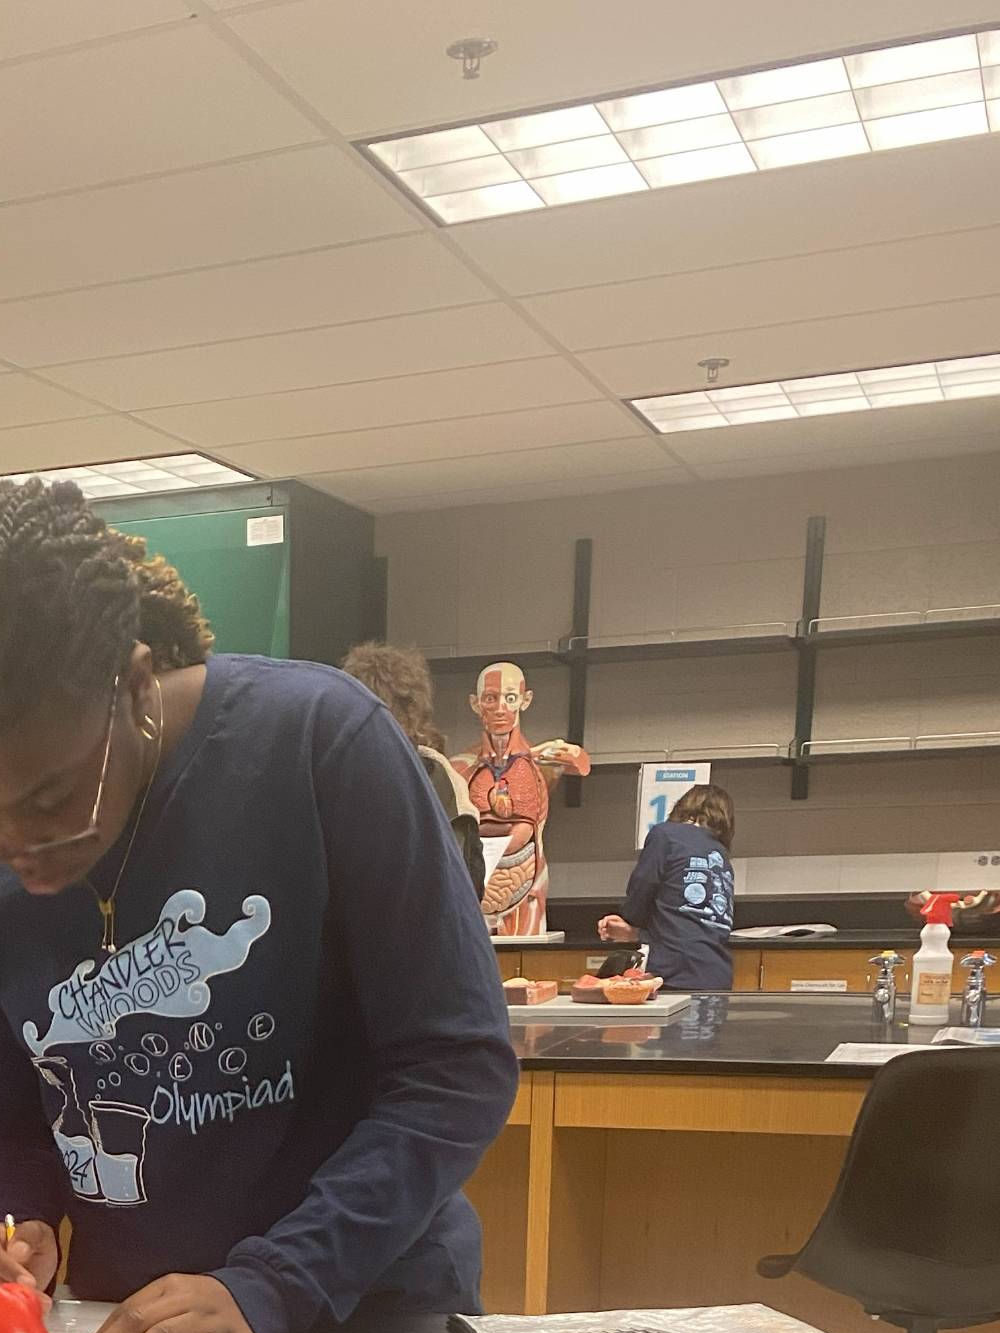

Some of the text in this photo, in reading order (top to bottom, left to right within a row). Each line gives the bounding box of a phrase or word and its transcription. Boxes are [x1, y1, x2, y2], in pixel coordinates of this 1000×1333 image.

[58, 917, 186, 1020] CHANDLER
[75, 950, 201, 1038] WOODS
[150, 1059, 295, 1135] Olympiad
